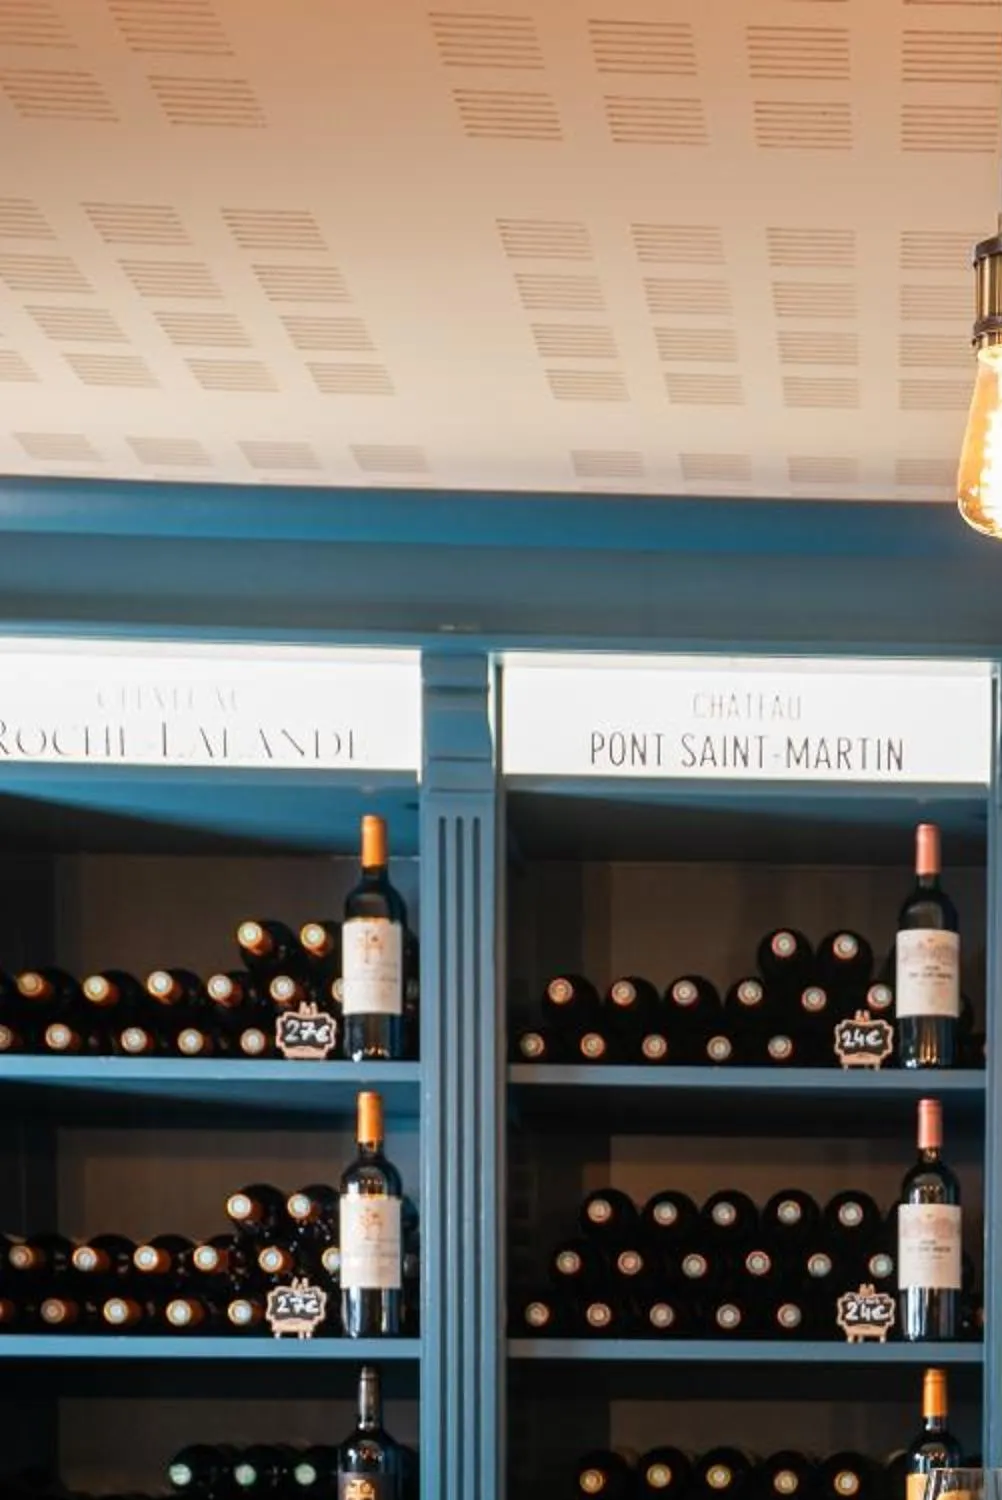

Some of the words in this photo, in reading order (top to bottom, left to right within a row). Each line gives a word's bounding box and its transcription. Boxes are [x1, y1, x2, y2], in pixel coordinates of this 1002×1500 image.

[590, 731, 665, 768] PONT
[680, 733, 904, 772] SAINT-MARTIN
[284, 1018, 329, 1044] 27€
[842, 1027, 882, 1049] 24€
[276, 1294, 319, 1315] 27€
[845, 1300, 890, 1322] 24€
